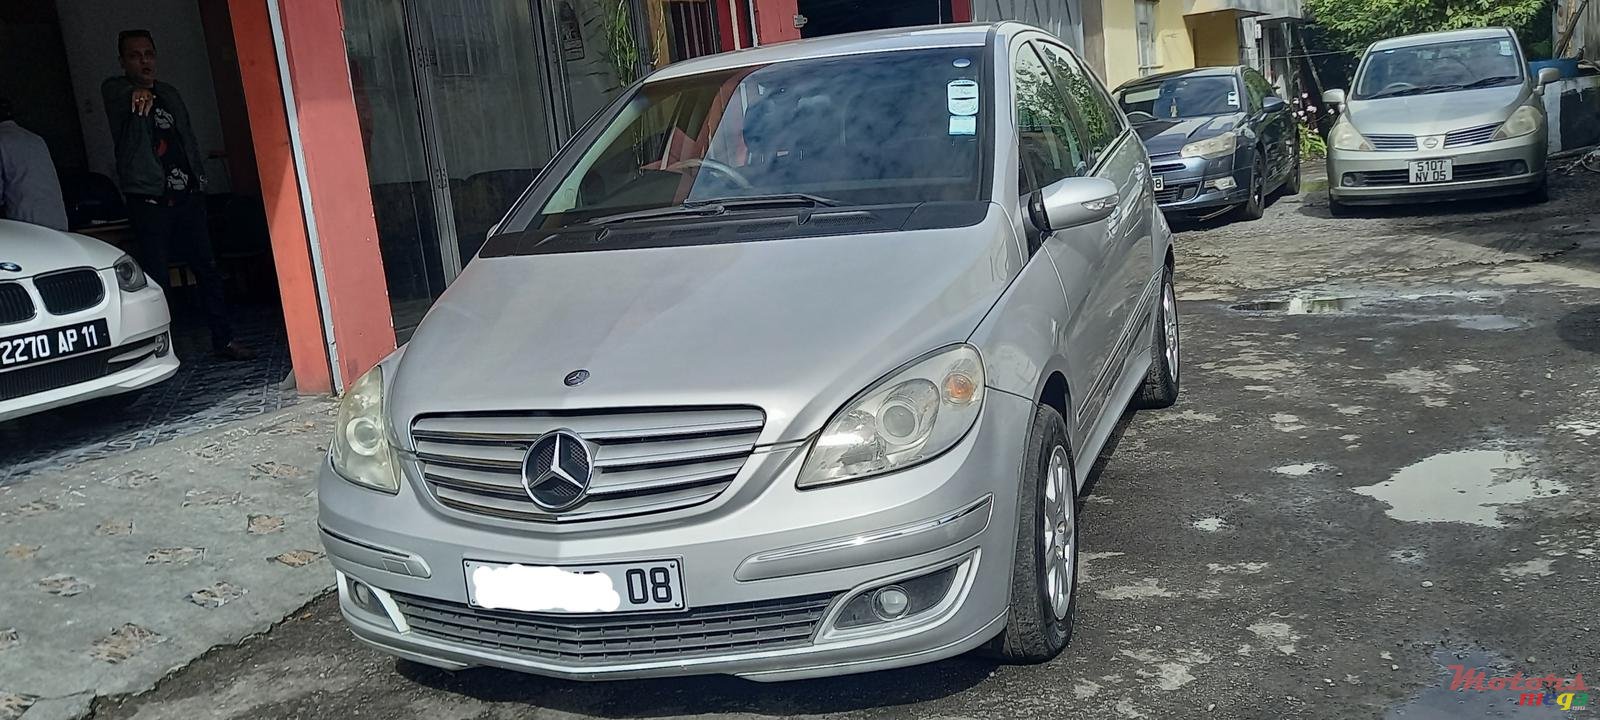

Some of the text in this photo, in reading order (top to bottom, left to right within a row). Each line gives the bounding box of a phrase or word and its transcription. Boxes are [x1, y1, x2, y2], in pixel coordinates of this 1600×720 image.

[1415, 171, 1446, 182] NV 05
[1417, 160, 1443, 171] 5107
[0, 324, 98, 365] 2270 AP 11
[626, 567, 672, 604] 08
